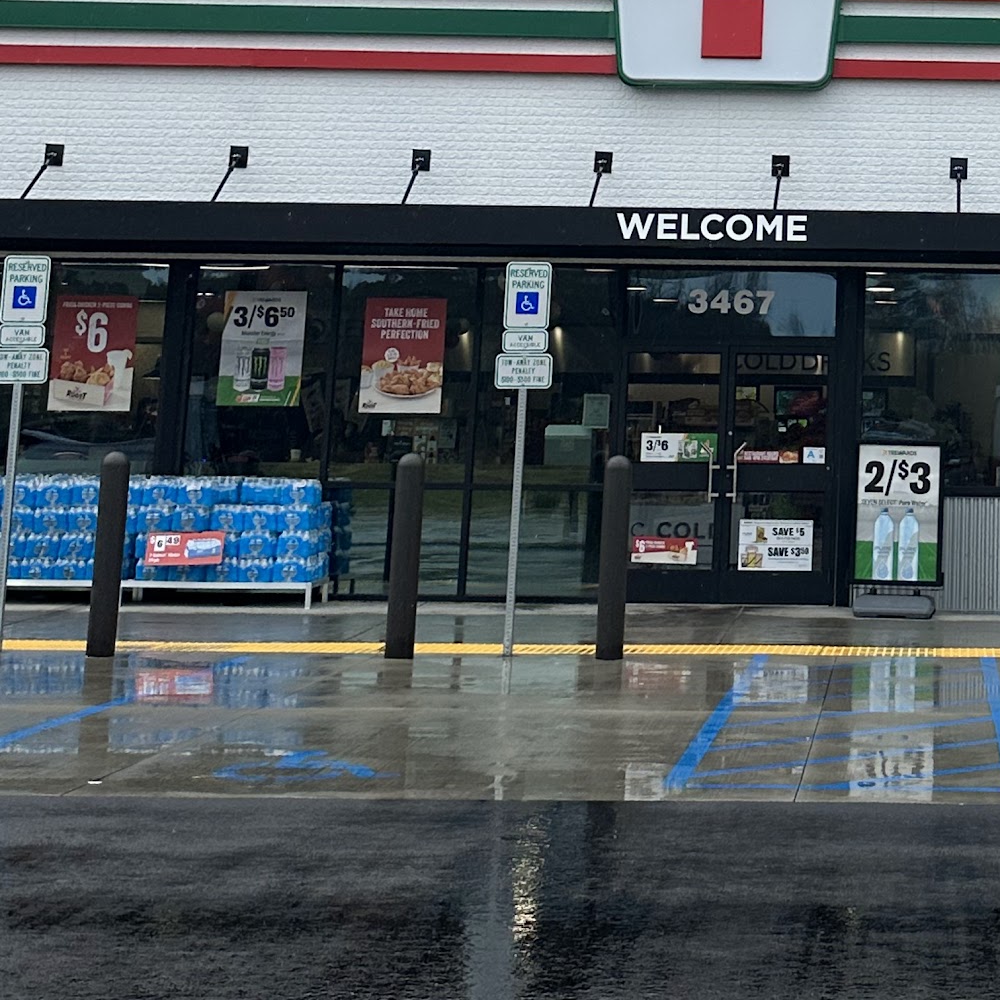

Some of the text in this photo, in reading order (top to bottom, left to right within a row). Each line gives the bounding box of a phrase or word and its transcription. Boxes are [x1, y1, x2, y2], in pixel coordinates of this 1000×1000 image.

[616, 212, 808, 242] WELCOME
[8, 262, 47, 272] RESERVED
[9, 274, 43, 283] PARKING
[510, 269, 548, 278] RESERVED
[512, 280, 545, 289] PARKING
[687, 289, 775, 315] 3467
[384, 307, 429, 318] TAKE HOME
[75, 309, 109, 353] $6
[380, 329, 430, 339] PERFECTION
[511, 367, 535, 375] PENALTY
[807, 450, 815, 459] A
[864, 459, 931, 496] 2/$3
[772, 527, 794, 537] SAVE
[635, 539, 646, 553] $6
[767, 546, 789, 557] SAVE
